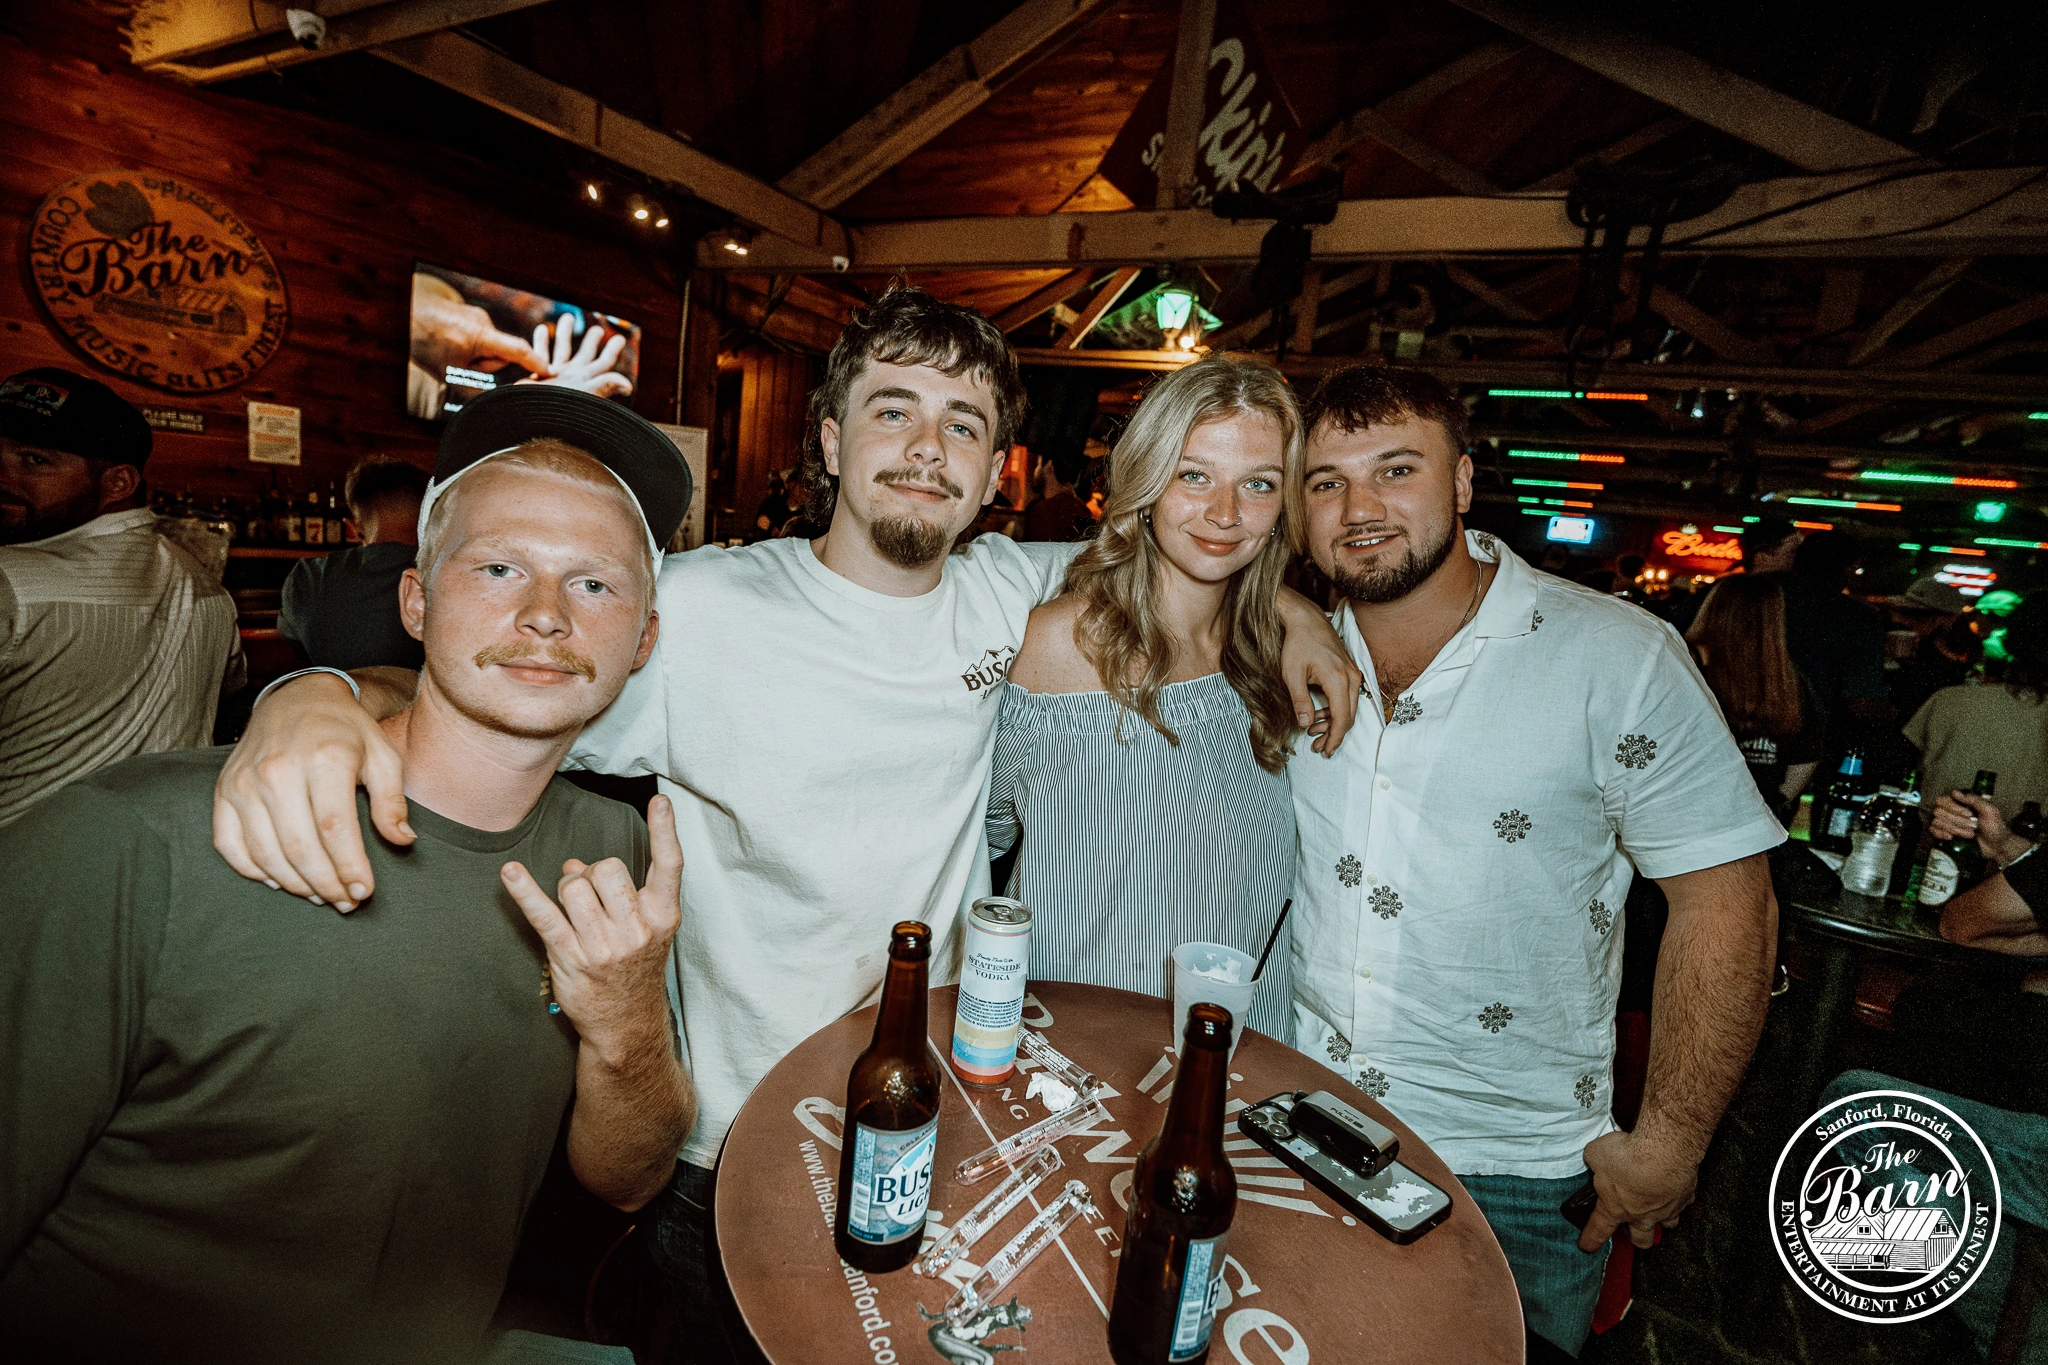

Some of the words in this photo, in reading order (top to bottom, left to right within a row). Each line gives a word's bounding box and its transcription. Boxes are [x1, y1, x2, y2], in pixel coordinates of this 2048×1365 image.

[128, 220, 209, 260] The
[31, 196, 82, 305] COUNTRY
[62, 314, 159, 380] MUSIC
[242, 297, 286, 370] FINEST
[61, 237, 251, 298] Barn
[968, 954, 1021, 972] STATESIDE
[975, 969, 1011, 980] VODKA
[876, 1161, 933, 1203] BUS
